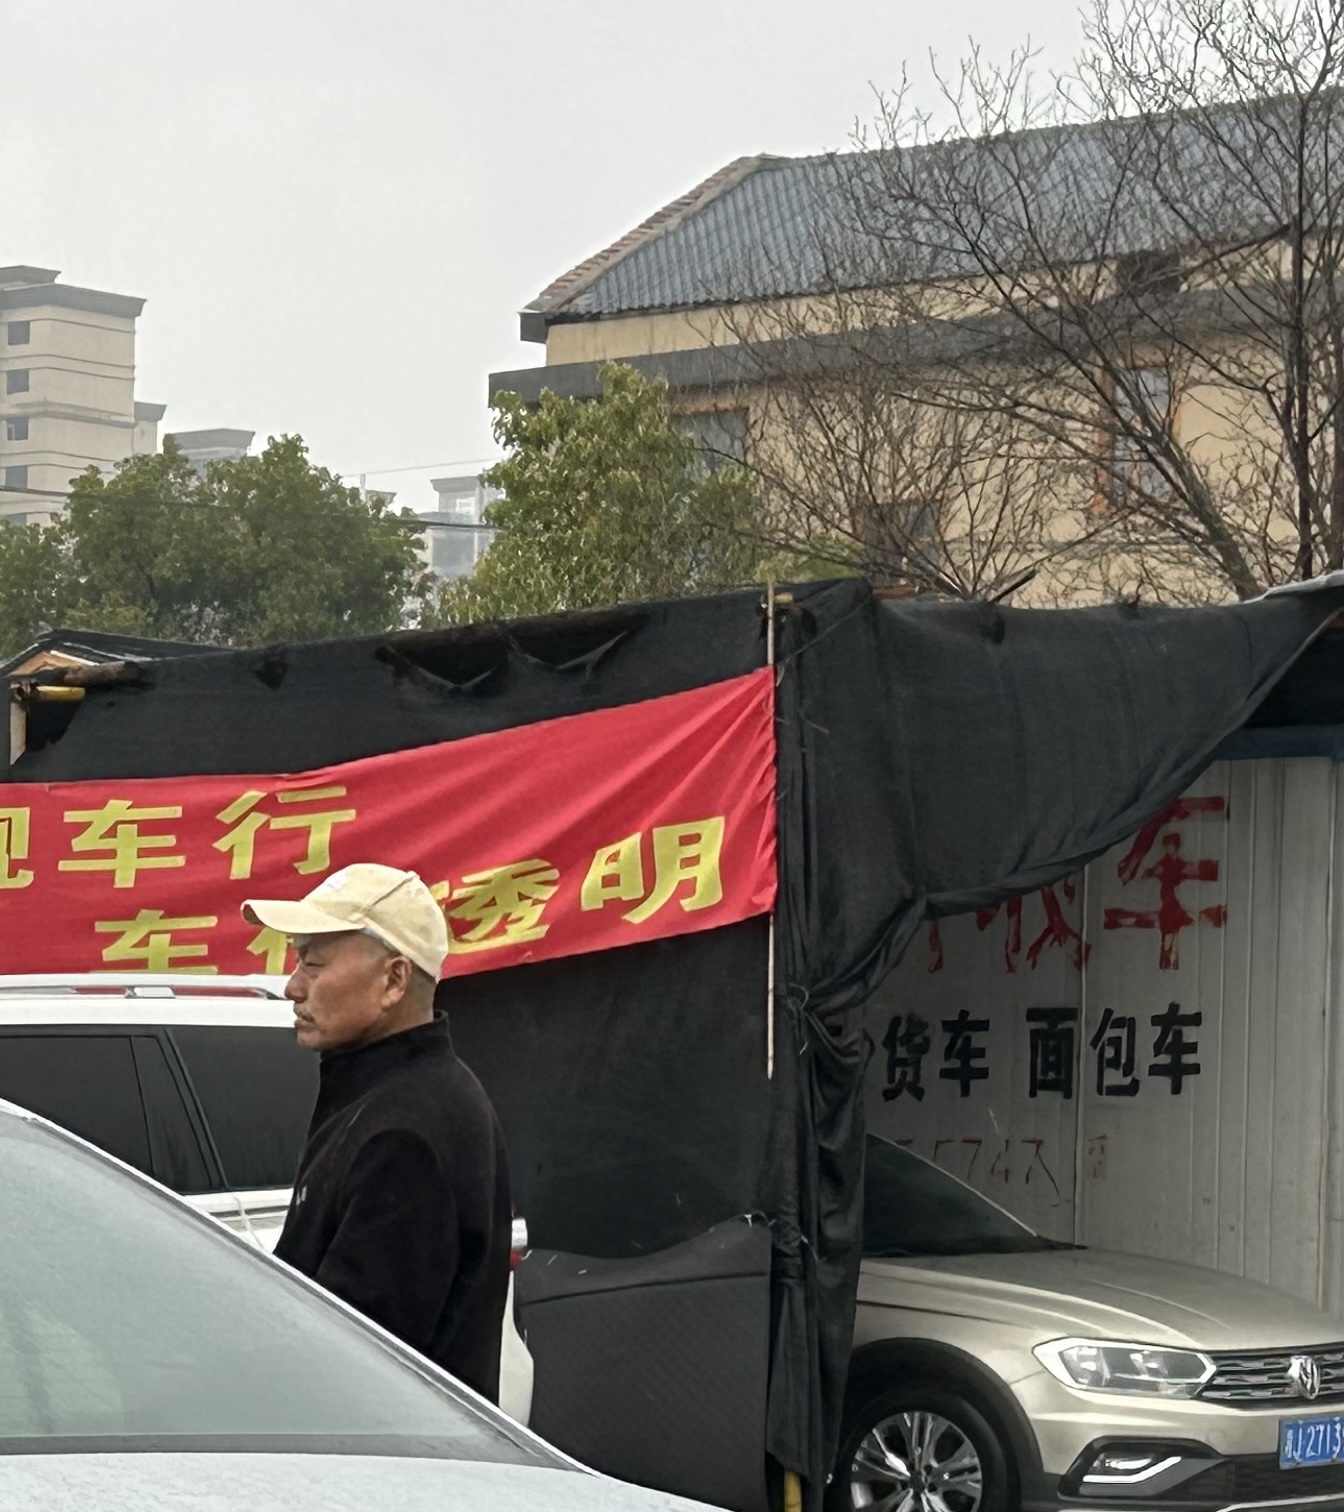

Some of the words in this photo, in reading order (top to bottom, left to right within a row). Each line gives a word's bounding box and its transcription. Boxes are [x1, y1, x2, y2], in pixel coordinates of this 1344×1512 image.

[94, 816, 728, 976] 车透明
[881, 1008, 990, 1102] 货车
[1025, 1003, 1203, 1100] 面包车
